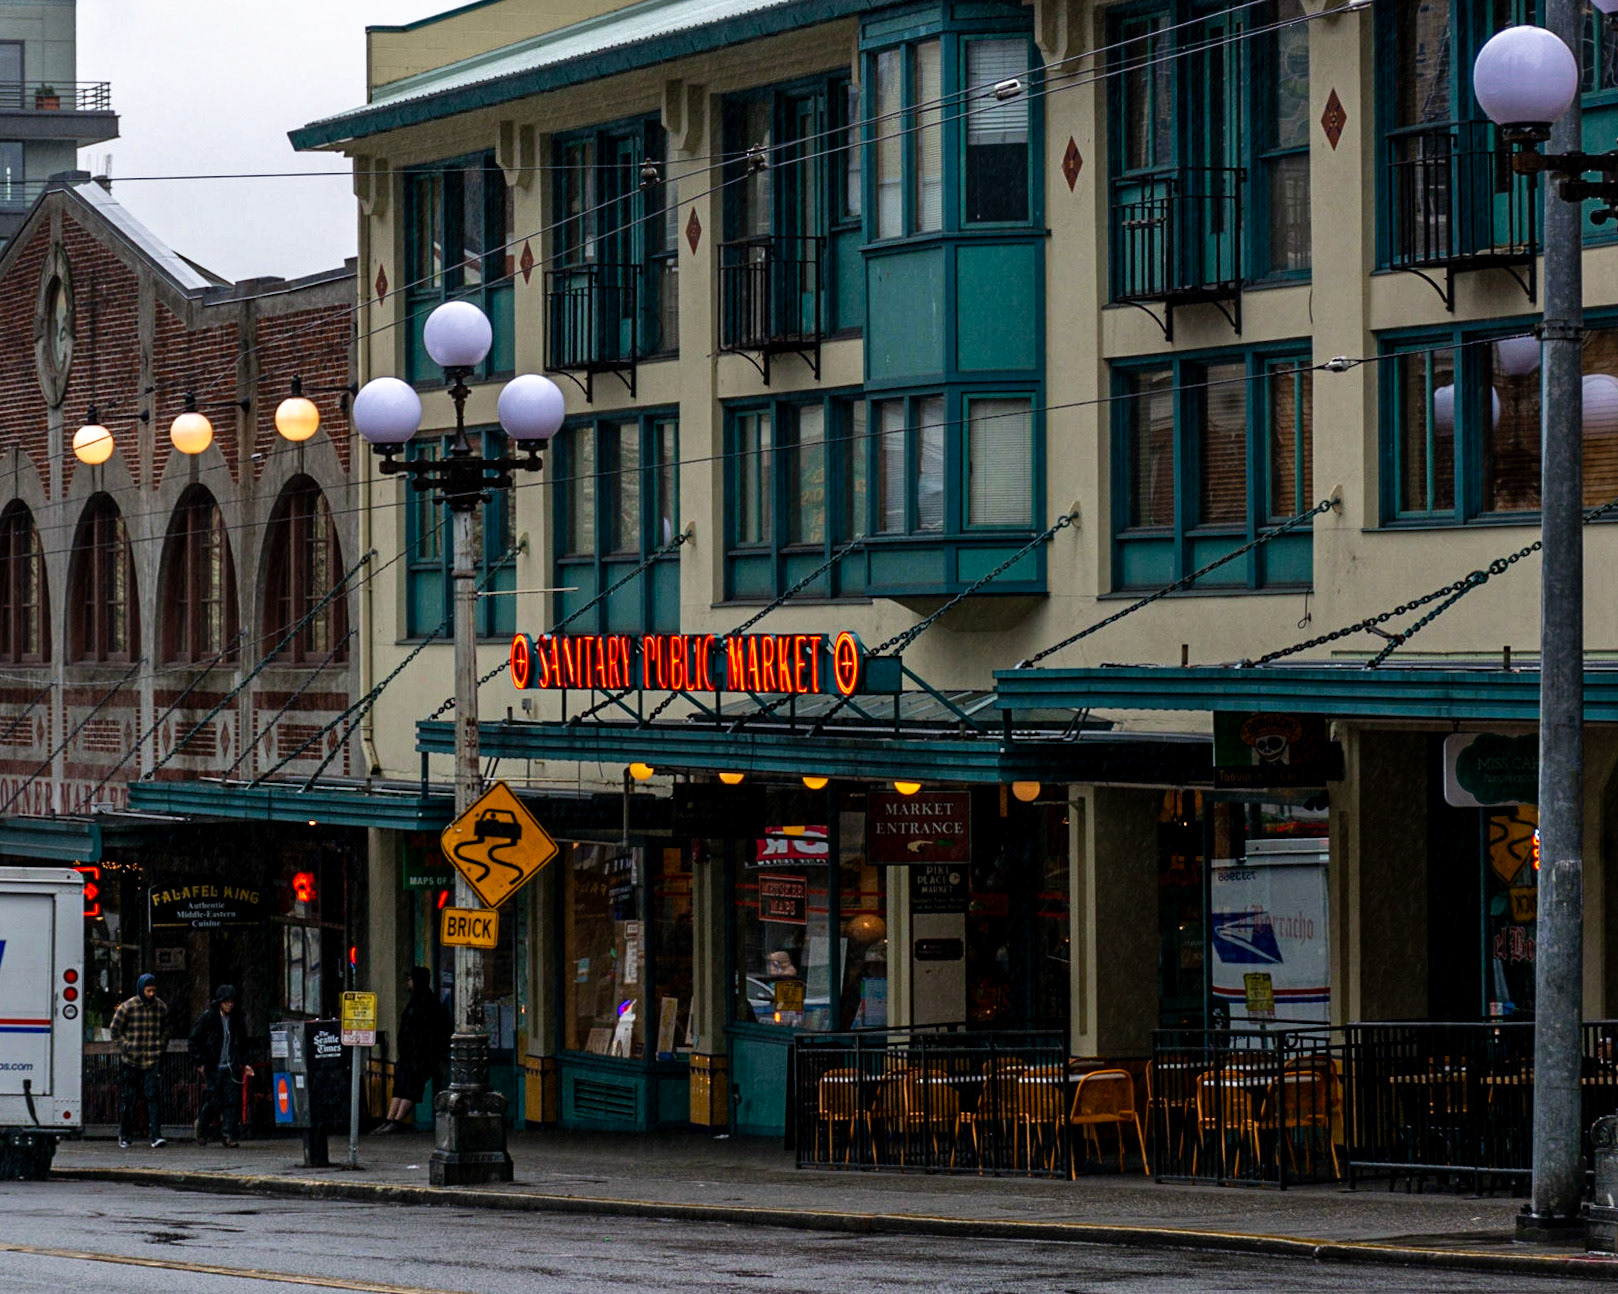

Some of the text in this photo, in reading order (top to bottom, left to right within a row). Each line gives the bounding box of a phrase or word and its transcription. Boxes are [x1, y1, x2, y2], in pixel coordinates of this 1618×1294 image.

[538, 634, 822, 693] SANITARY PUBLIC MARKET
[885, 802, 954, 816] MARKET
[876, 822, 964, 835] ENTRANCE
[926, 866, 952, 875] PIKE
[409, 877, 435, 885] MAPS
[436, 877, 449, 885] OF
[917, 875, 948, 885] PLACE
[921, 886, 953, 895] MARKET
[151, 885, 261, 907] FALAFEL KING
[188, 901, 225, 909] Authentic
[176, 910, 237, 919] Middle-Eastern
[191, 919, 222, 928] Cuisine
[447, 916, 491, 939] BRICK
[1250, 904, 1315, 946] Borracho
[1493, 926, 1508, 960] el
[313, 1034, 339, 1045] Seattle
[316, 1044, 342, 1054] Times
